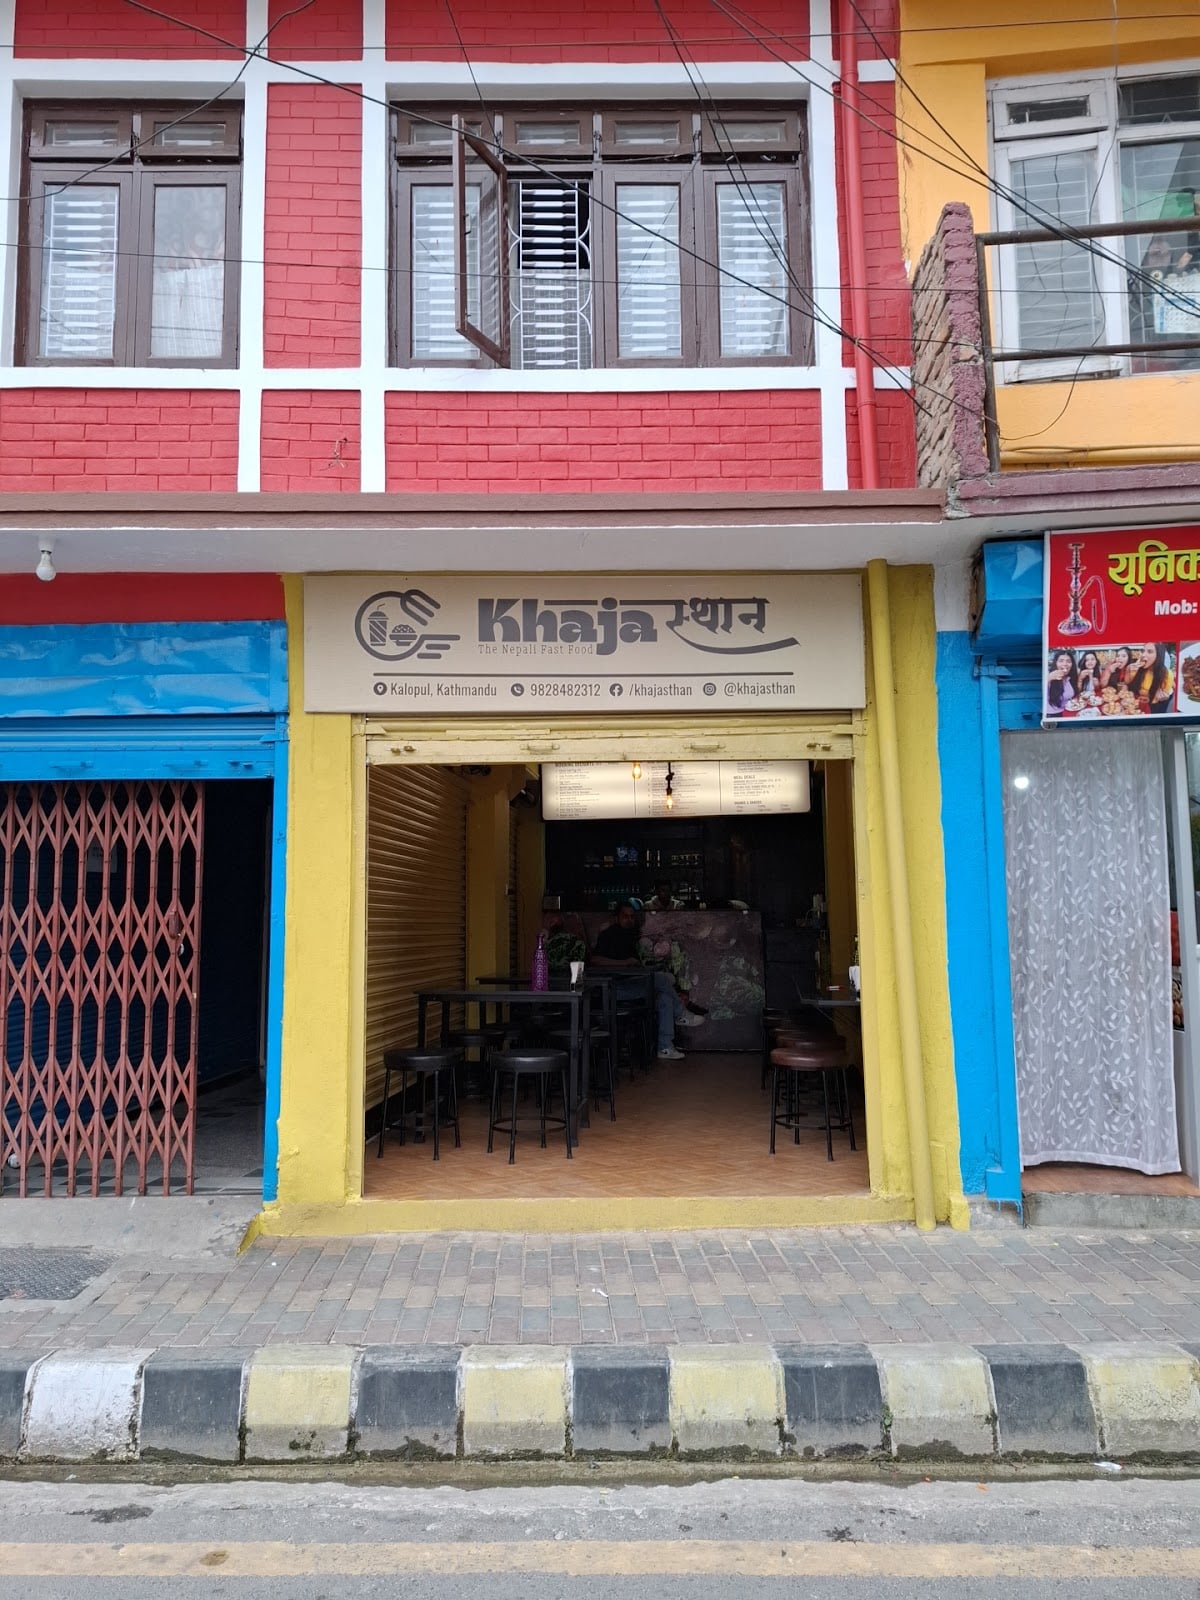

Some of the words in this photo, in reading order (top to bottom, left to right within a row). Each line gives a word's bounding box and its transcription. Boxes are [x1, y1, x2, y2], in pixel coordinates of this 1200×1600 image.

[1154, 599, 1198, 616] Mob:
[478, 597, 657, 655] Khaja
[478, 644, 498, 655] The
[502, 644, 536, 657] Nepali
[541, 644, 564, 655] Fast
[568, 644, 593, 655] Food
[390, 683, 433, 697] Kalopul,
[437, 683, 497, 697] Kathmandu
[530, 683, 601, 697] 9828482312
[629, 682, 692, 698] /khajasthan
[724, 682, 796, 697] @khajasthan
